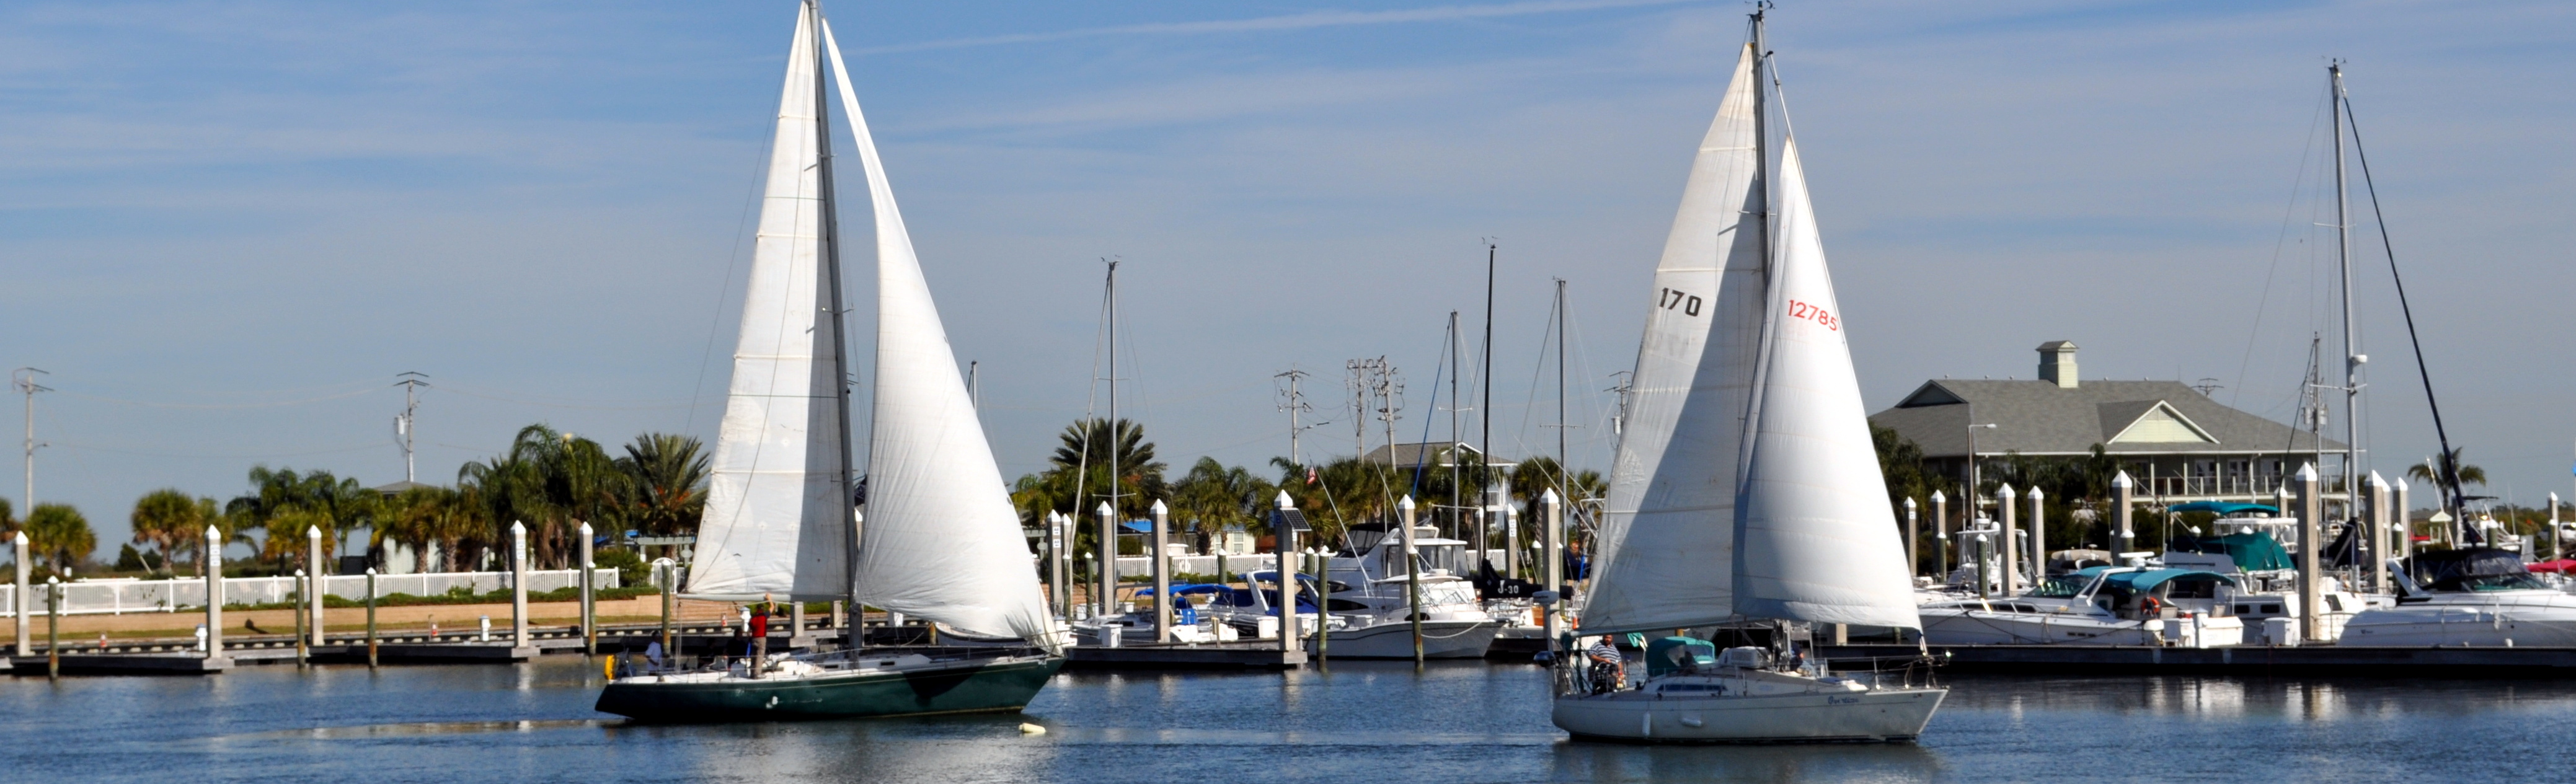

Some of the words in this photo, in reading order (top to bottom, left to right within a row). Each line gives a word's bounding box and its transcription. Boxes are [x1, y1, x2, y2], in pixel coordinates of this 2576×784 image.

[1659, 287, 1702, 317] 170
[1787, 299, 1838, 332] 12785
[1498, 579, 1519, 594] J-30
